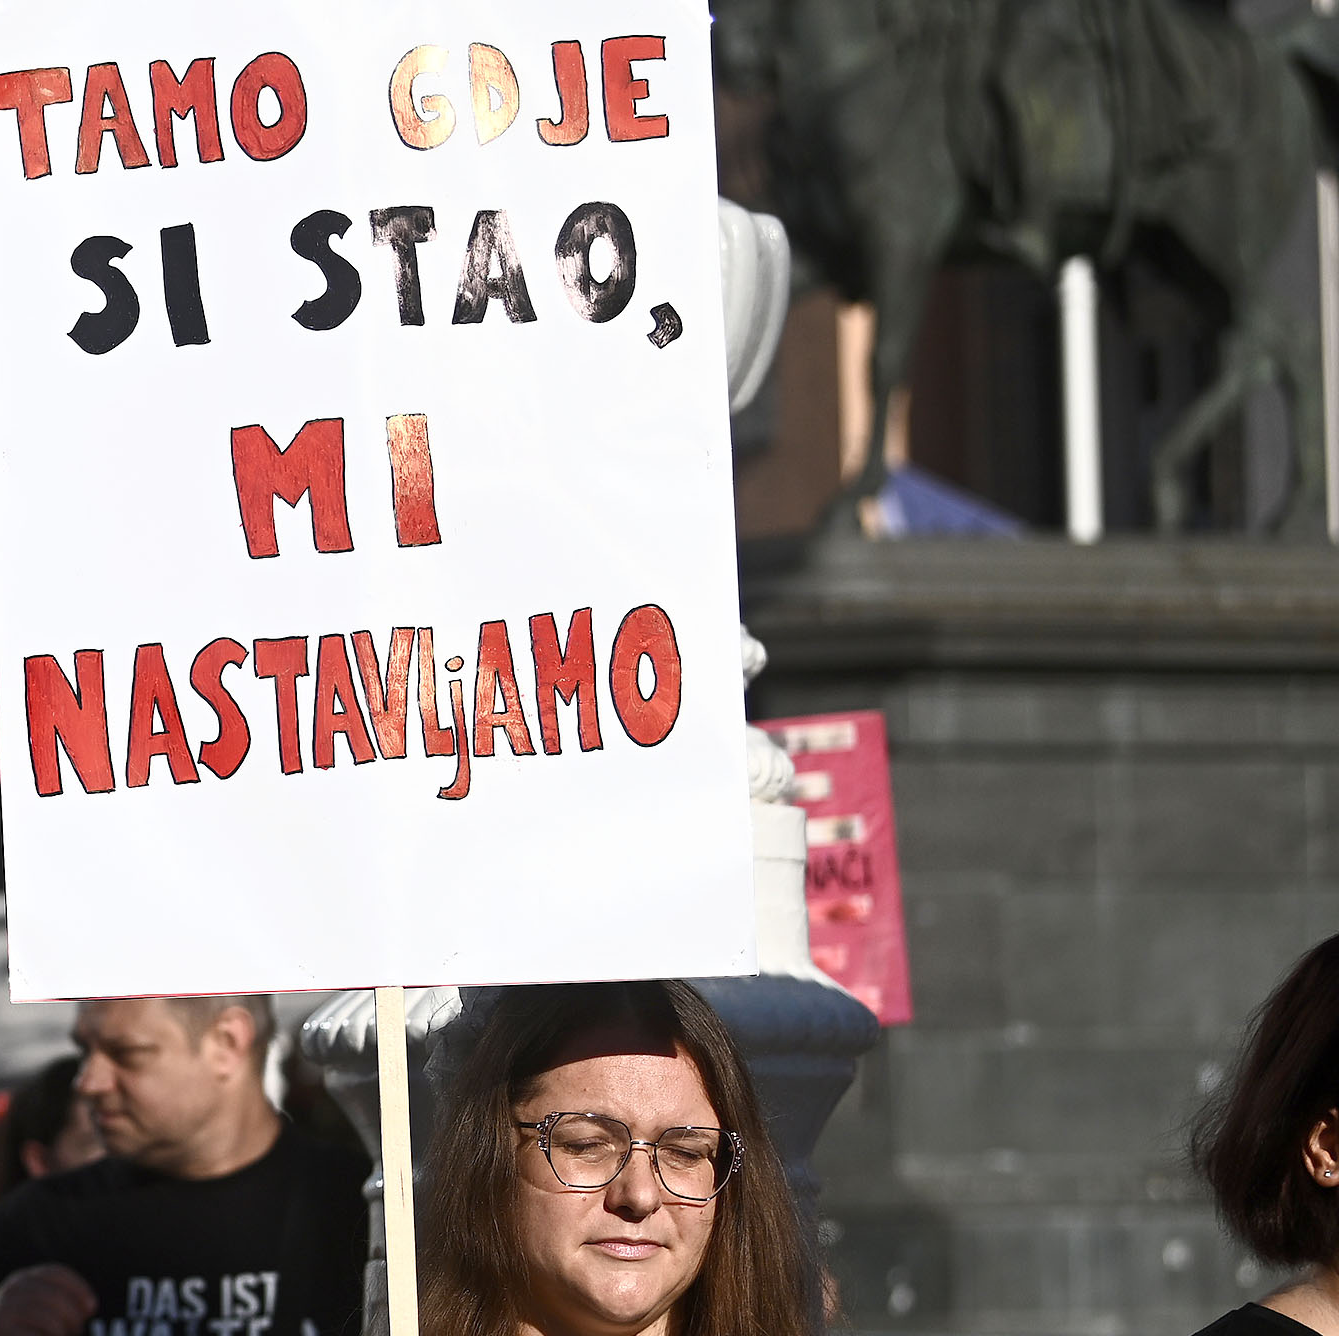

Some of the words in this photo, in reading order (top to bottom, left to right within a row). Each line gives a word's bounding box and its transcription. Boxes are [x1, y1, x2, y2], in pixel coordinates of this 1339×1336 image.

[388, 35, 670, 151] GDJE
[67, 222, 212, 356] SI
[290, 200, 684, 350] STAO,
[229, 412, 443, 560] MI
[126, 1274, 209, 1320] DAS
[219, 1270, 280, 1318] IST
